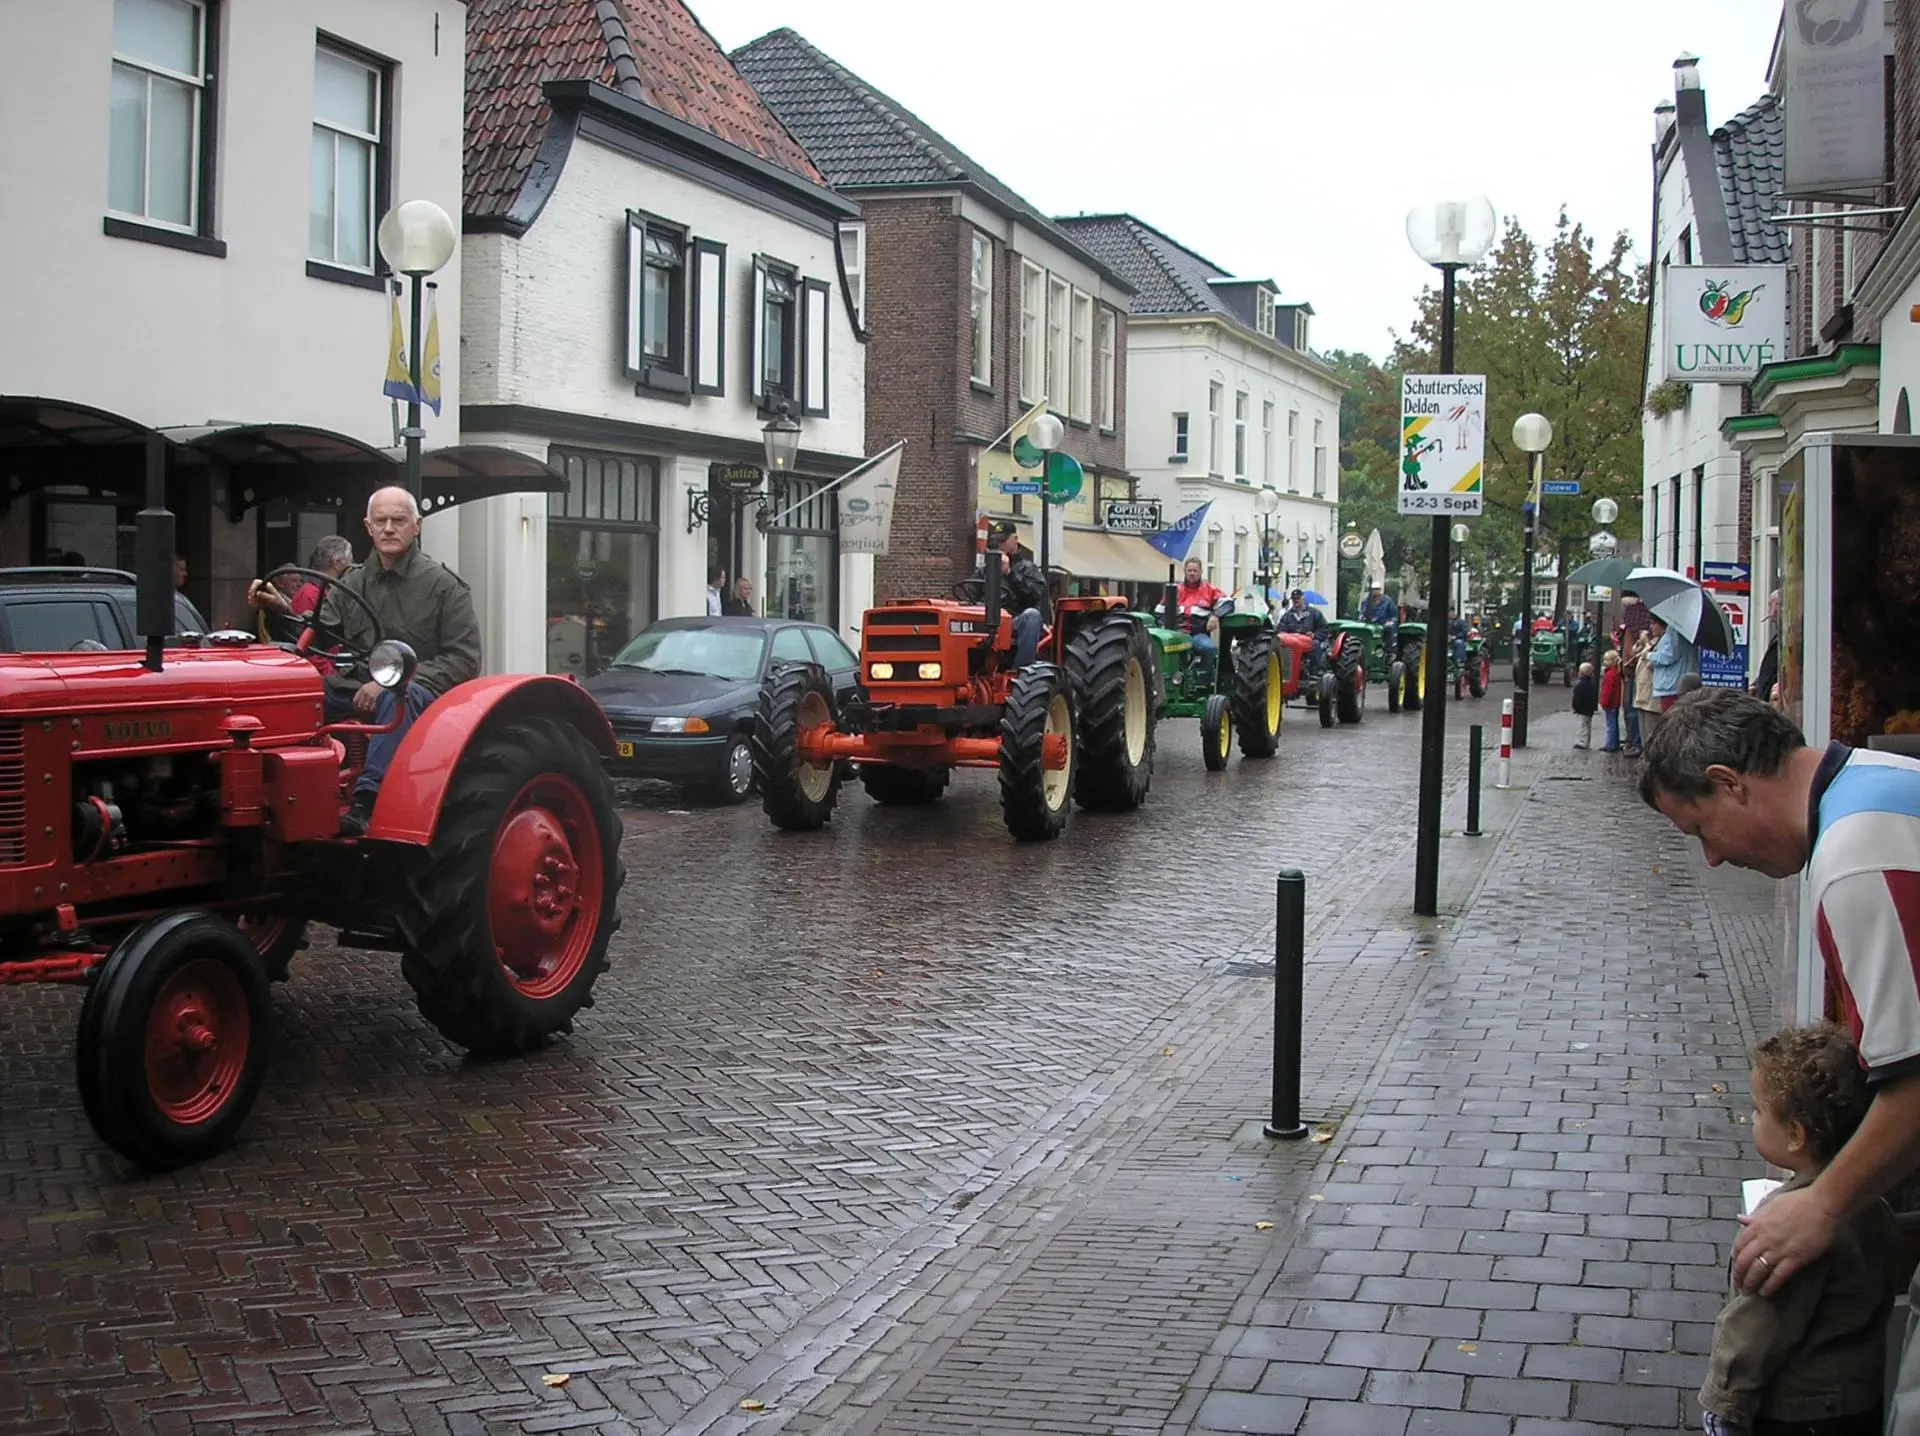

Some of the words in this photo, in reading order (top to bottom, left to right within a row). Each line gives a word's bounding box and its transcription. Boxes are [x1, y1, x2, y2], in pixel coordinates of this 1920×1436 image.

[1404, 377, 1484, 396] Schuttersfeest
[1404, 397, 1440, 414] Delden
[1114, 504, 1151, 515] OPTIEK
[1403, 497, 1439, 509] 1-2-3
[1443, 497, 1479, 511] Sept
[1112, 519, 1153, 528] AARSEN
[103, 719, 173, 742] VOLVO
